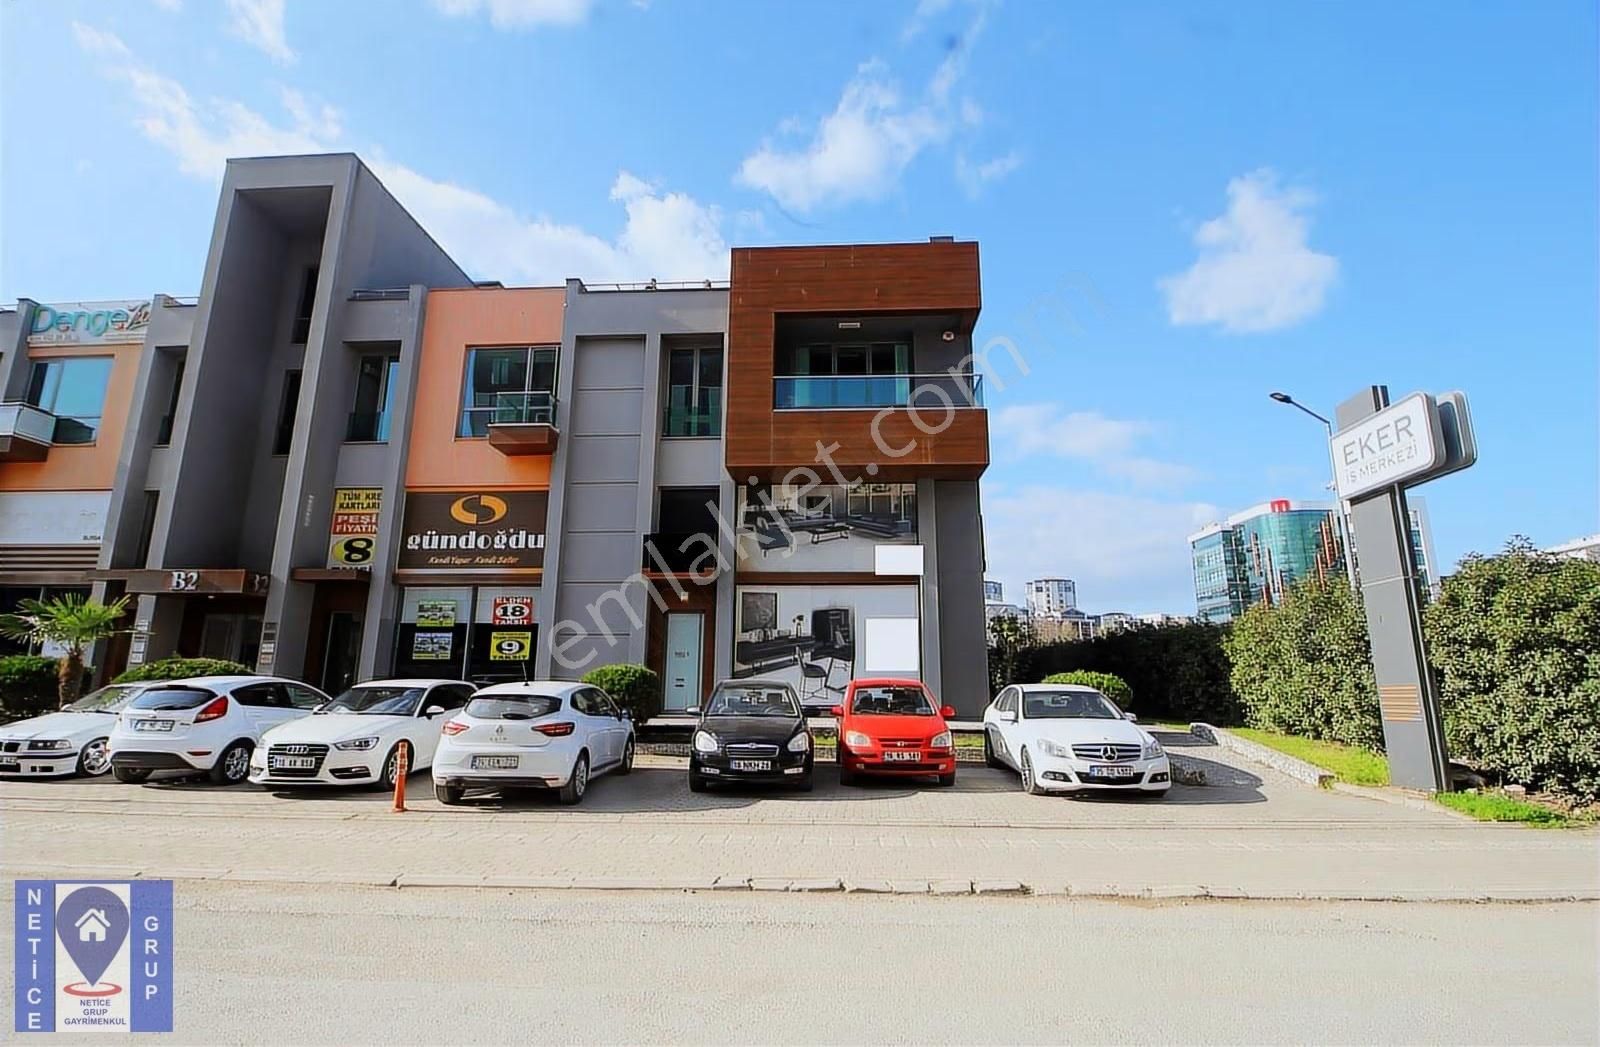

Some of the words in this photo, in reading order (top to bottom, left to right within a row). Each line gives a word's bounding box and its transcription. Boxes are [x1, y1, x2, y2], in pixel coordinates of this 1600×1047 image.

[32, 304, 128, 337] Denge
[1343, 415, 1414, 465] EKER
[1360, 439, 1418, 476] MERKEZİ
[343, 488, 361, 500] TÜM
[343, 537, 374, 563] 8
[171, 571, 199, 591] B2
[500, 605, 525, 617] 18
[501, 640, 520, 654] 9
